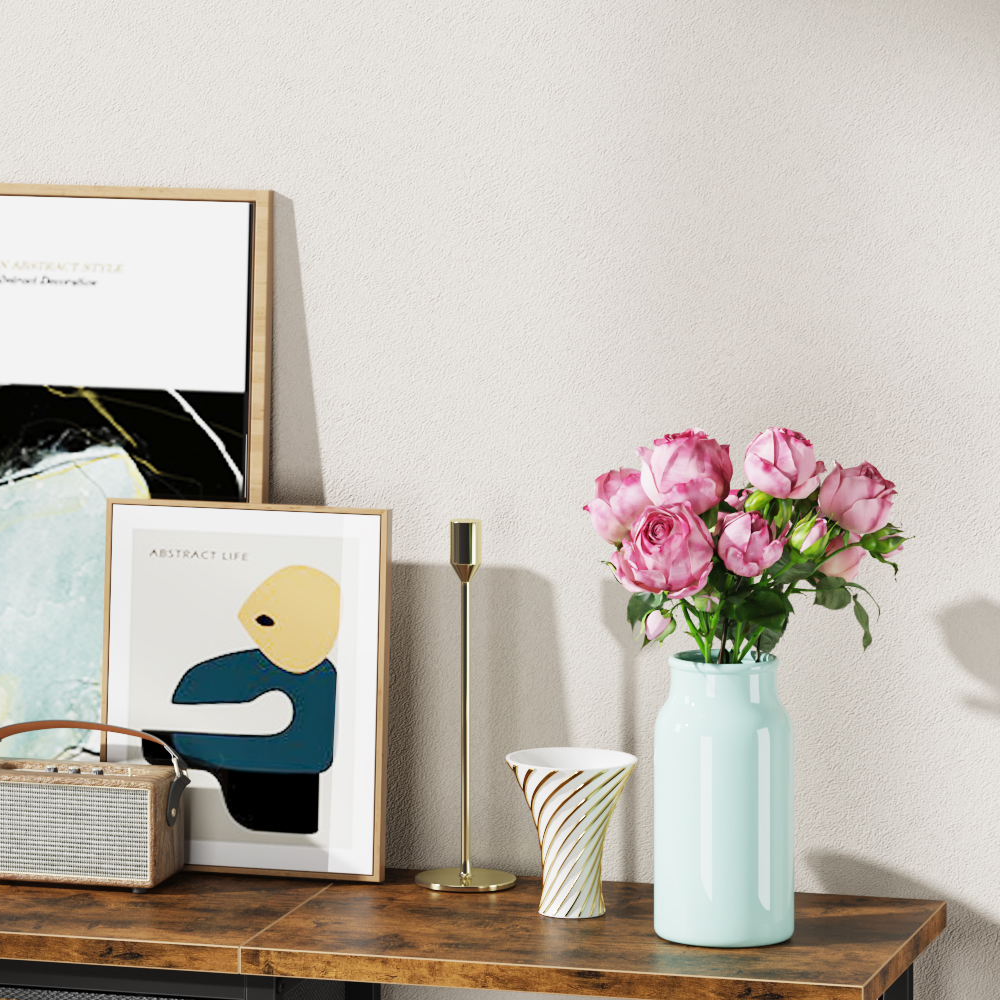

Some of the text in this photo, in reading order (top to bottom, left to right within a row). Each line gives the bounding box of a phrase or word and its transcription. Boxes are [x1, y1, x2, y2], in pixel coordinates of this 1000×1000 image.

[81, 263, 125, 273] STYLE
[149, 548, 249, 561] ABSTRACT LIFE
